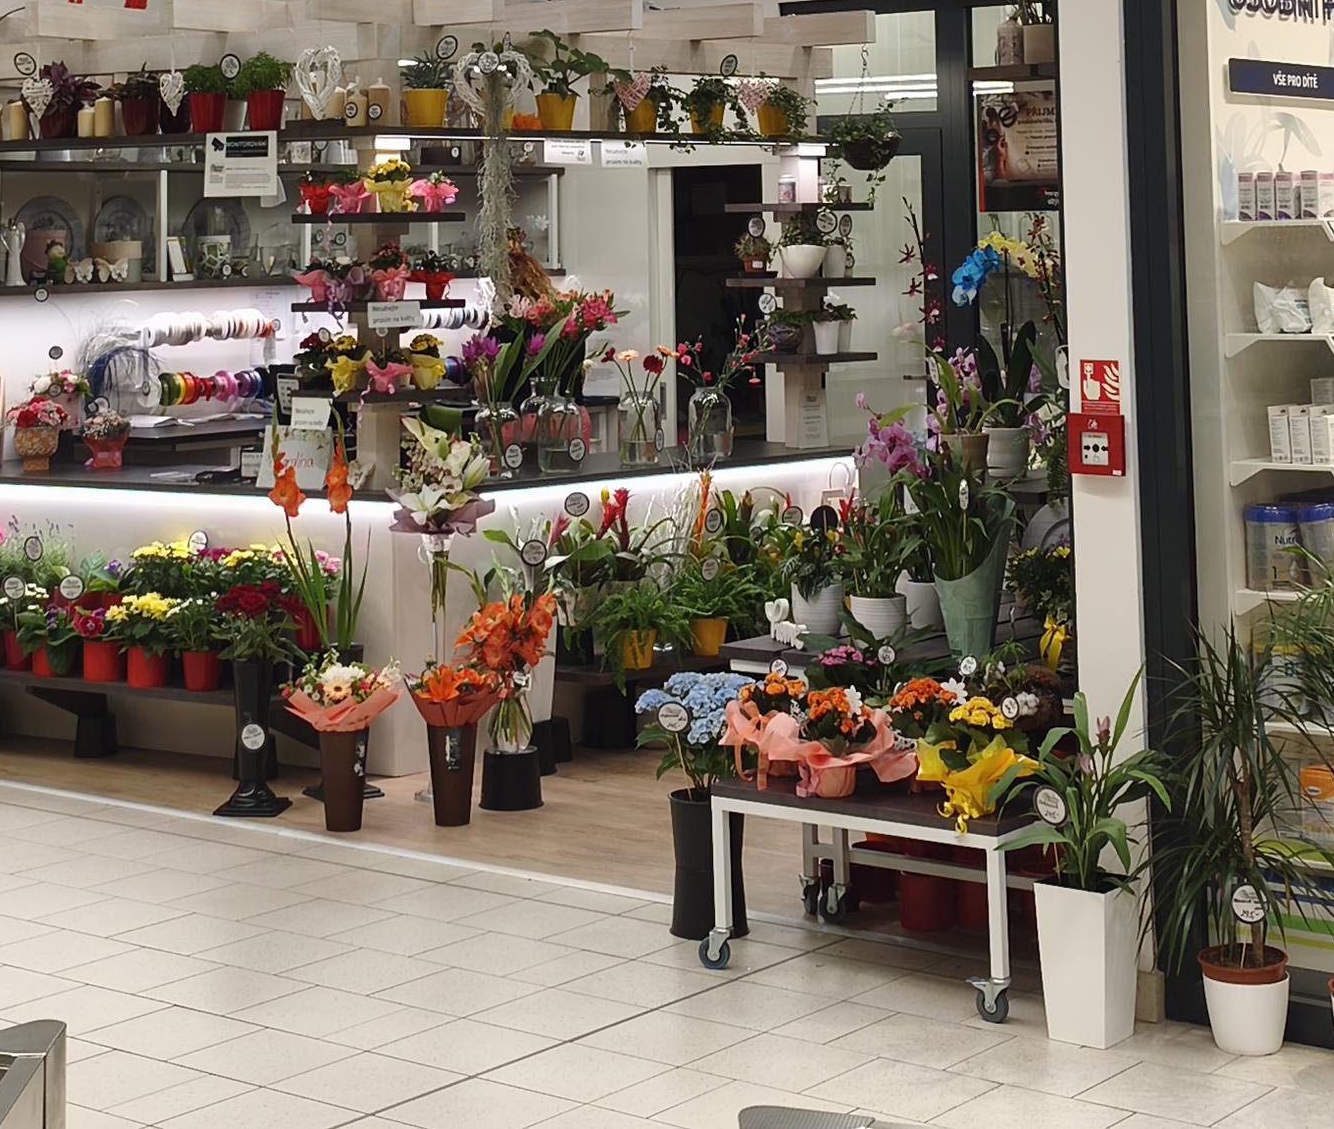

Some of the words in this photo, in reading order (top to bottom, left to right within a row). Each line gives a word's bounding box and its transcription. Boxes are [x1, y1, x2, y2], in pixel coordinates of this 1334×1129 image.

[1273, 70, 1286, 86] VŠE
[1287, 74, 1301, 87] PRO
[1302, 73, 1318, 88] DÍTĚ
